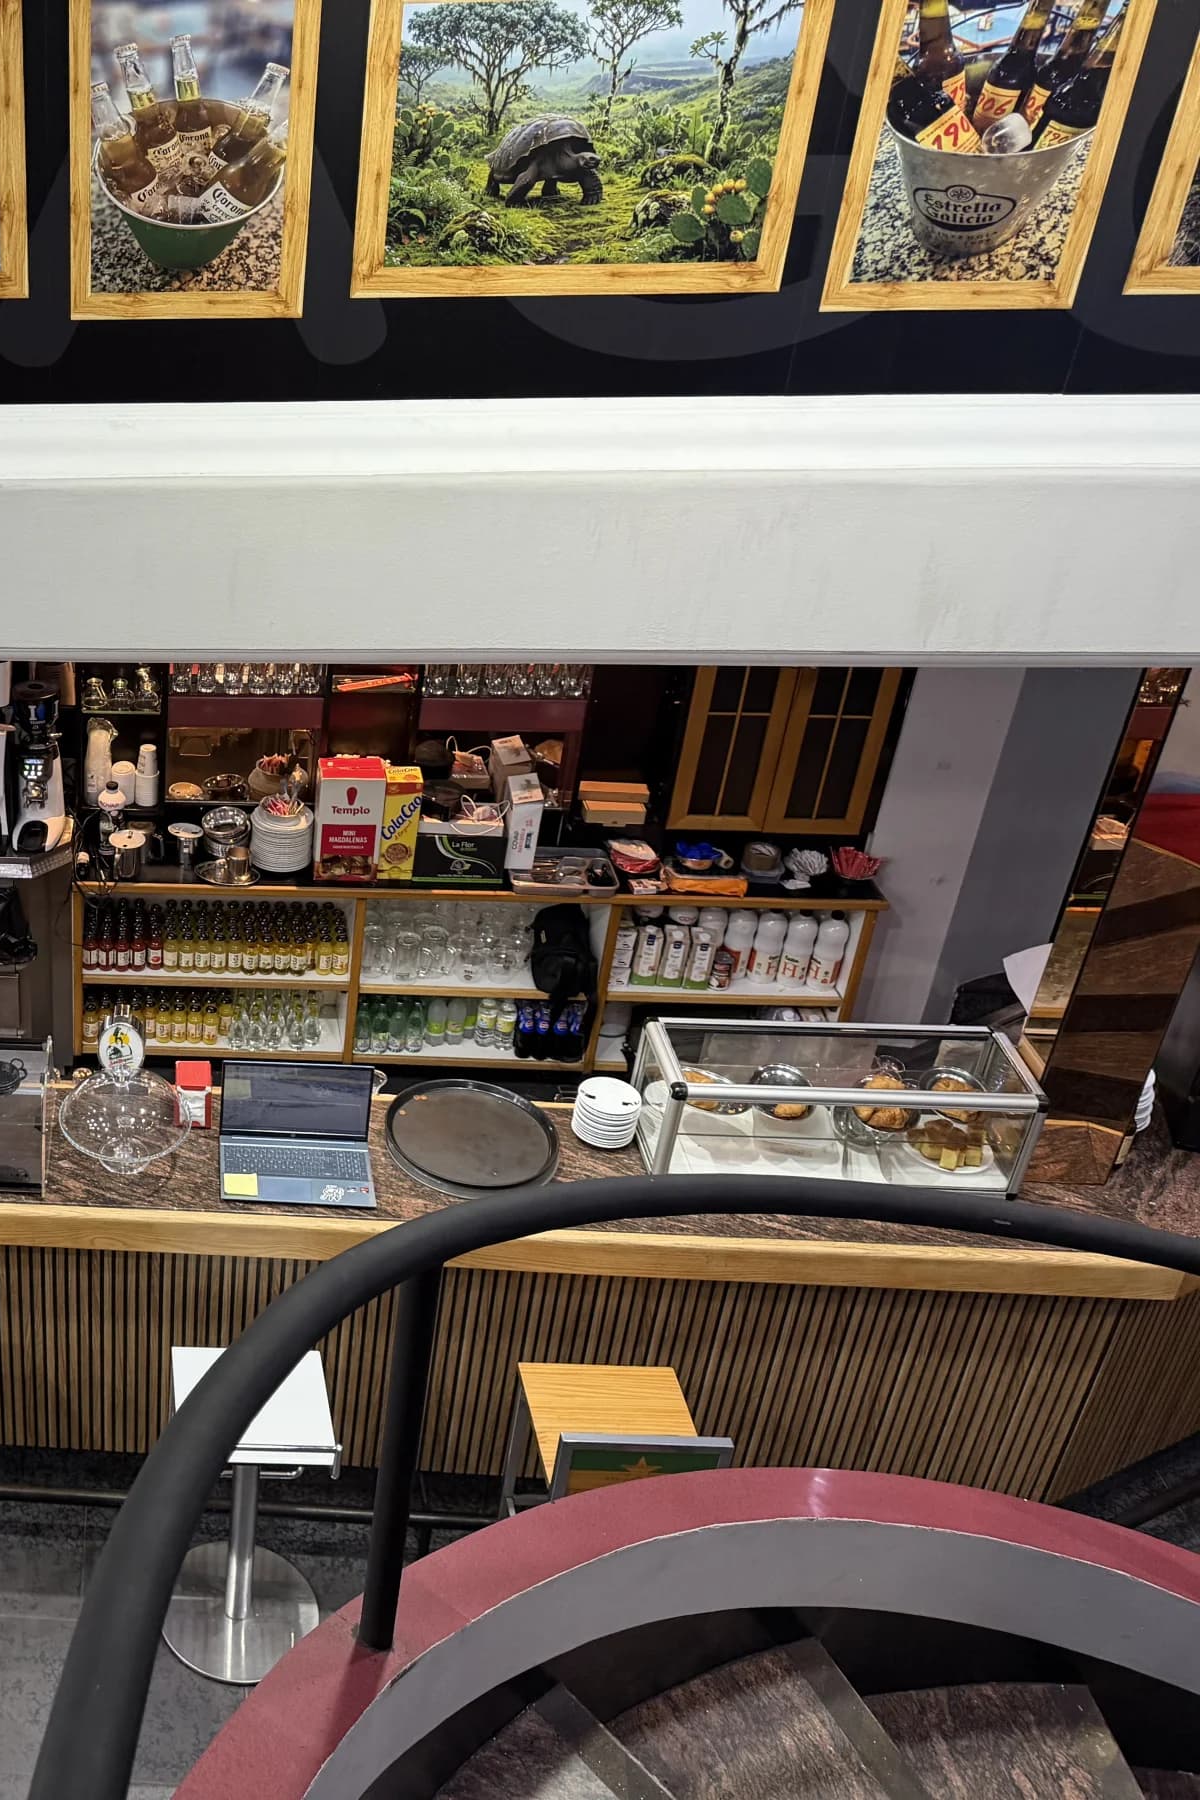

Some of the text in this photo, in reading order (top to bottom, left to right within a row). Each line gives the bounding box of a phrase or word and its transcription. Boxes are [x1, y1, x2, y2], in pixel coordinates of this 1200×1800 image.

[179, 131, 209, 143] Corona
[924, 193, 1002, 213] Estrella
[927, 206, 994, 223] Galicia
[331, 805, 371, 816] Templo
[381, 795, 422, 840] ColaCao
